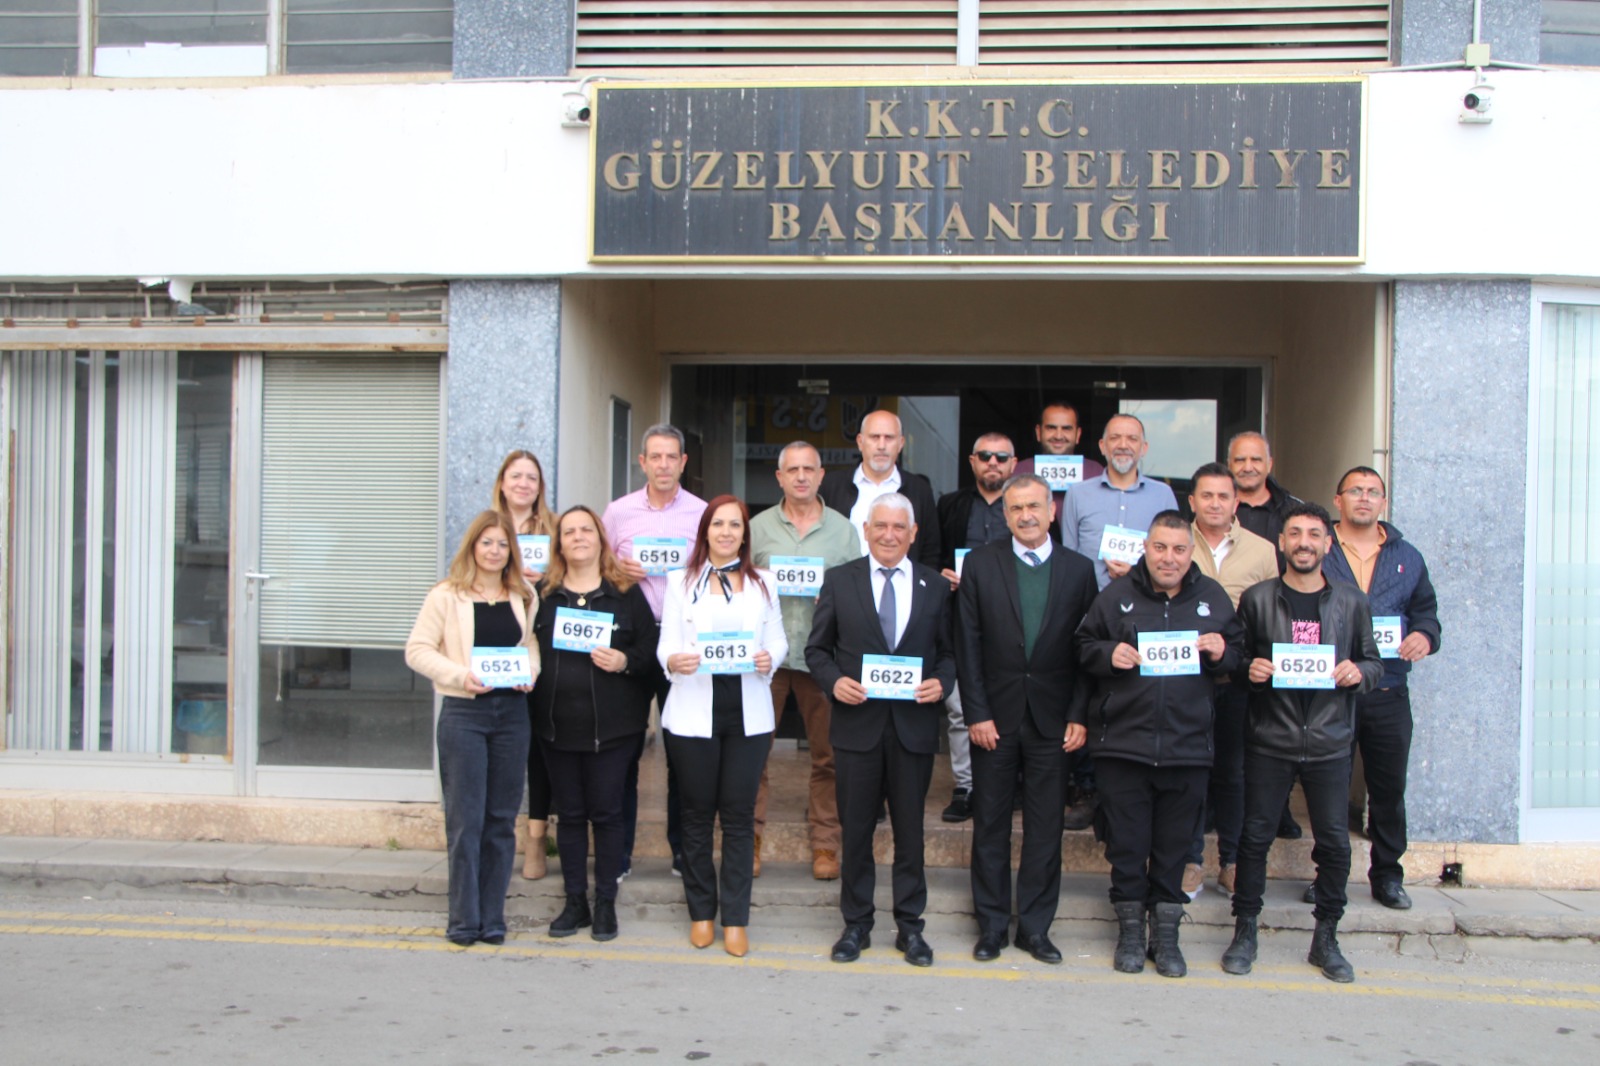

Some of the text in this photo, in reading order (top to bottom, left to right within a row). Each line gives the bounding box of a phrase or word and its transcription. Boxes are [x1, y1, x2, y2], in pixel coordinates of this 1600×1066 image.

[865, 99, 1089, 139] K.K.T.C.
[603, 137, 1352, 191] GÜZELYURT BELEDİYE
[768, 194, 1171, 252] BAŞKANLIĞI
[1041, 467, 1077, 478] 6334
[521, 547, 543, 559] 26
[640, 550, 680, 563] 6519
[777, 570, 816, 582] 6619
[562, 622, 604, 640] 6967
[1373, 630, 1394, 644] 25
[704, 645, 747, 659] 6613
[1147, 645, 1191, 661] 6618
[481, 659, 521, 673] 6521
[1281, 658, 1327, 673] 6520
[870, 669, 913, 685] 6622
